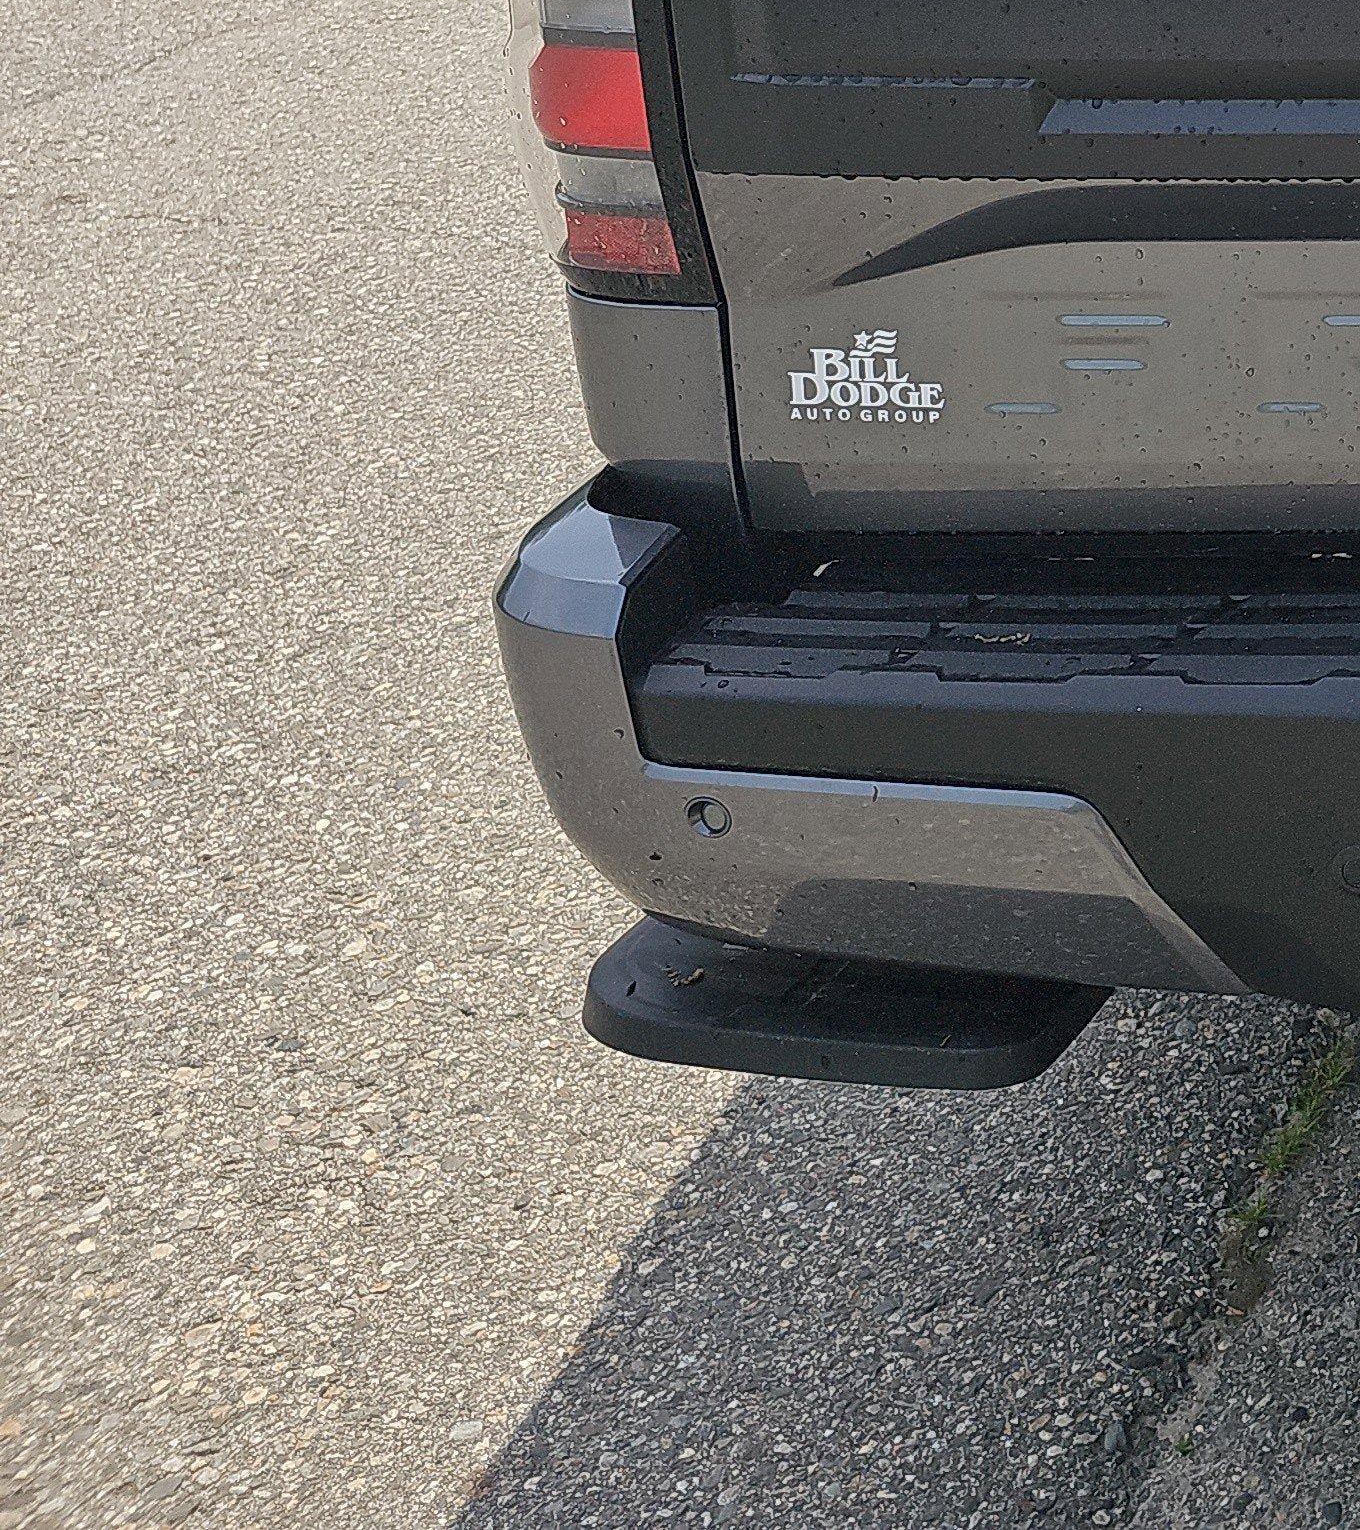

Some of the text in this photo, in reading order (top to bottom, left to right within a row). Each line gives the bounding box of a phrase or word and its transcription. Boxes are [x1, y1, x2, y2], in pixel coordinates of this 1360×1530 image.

[809, 348, 910, 383] BILL
[787, 372, 946, 409] DODGE
[790, 408, 941, 424] AUTO GROUP
